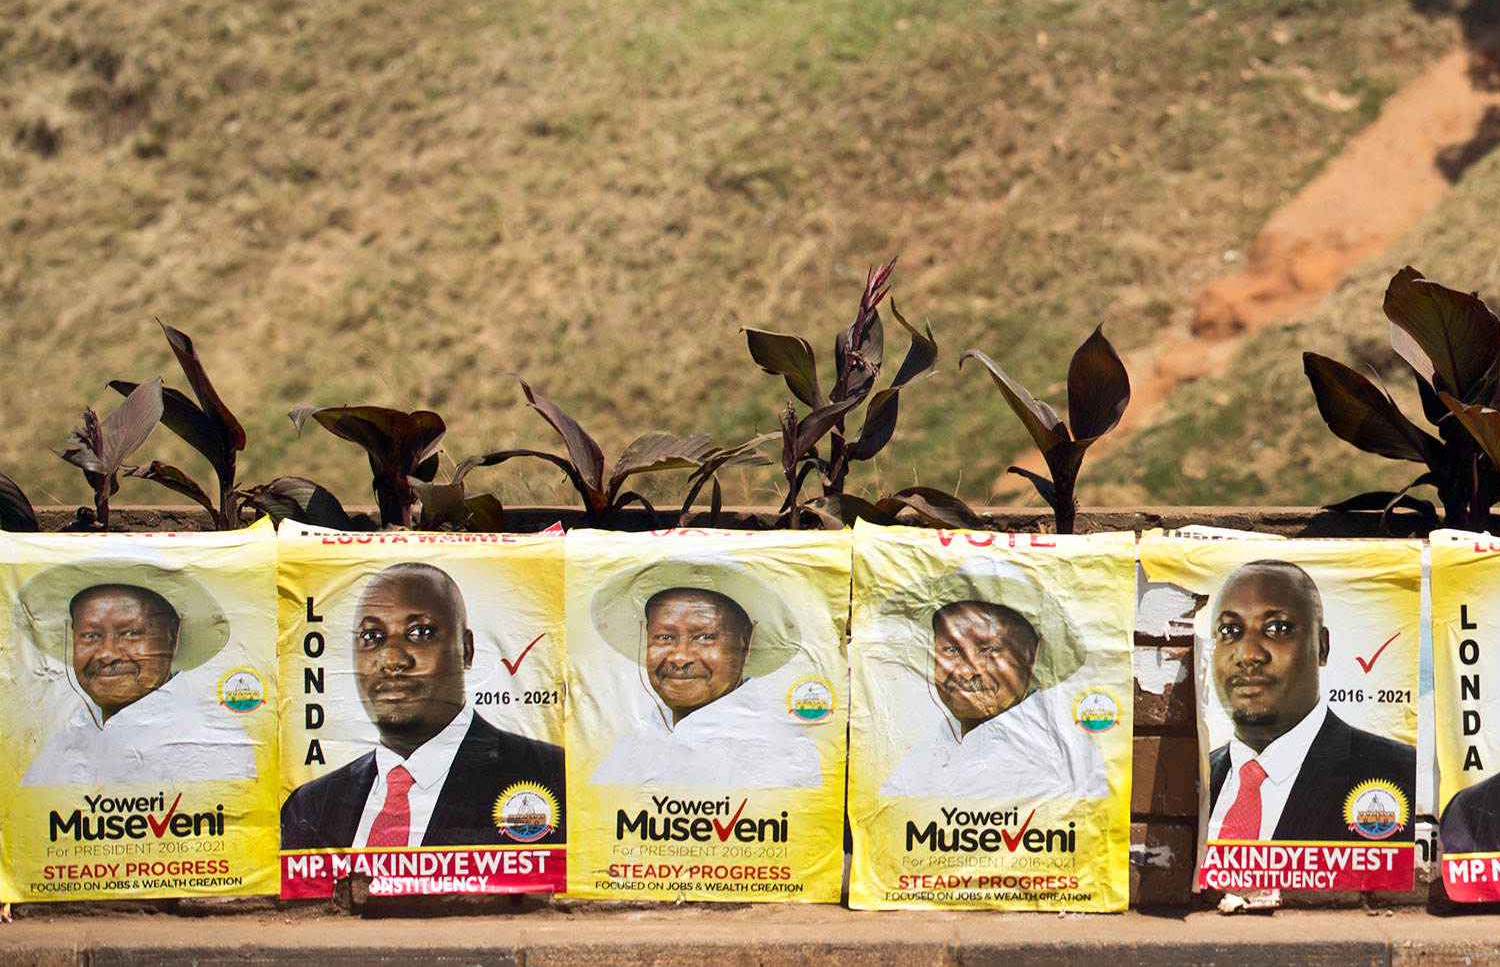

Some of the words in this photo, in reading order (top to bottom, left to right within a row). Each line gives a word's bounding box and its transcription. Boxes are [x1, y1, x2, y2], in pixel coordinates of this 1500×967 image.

[304, 596, 326, 765] LONDA
[1459, 604, 1484, 771] LONDA
[474, 691, 511, 705] 2016
[524, 691, 558, 705] 2021
[1329, 689, 1364, 703] 2016
[1377, 690, 1411, 703] 2021
[84, 792, 164, 813] Yoweri
[652, 796, 730, 816] Yoweri
[49, 793, 225, 842] Museveni
[616, 798, 788, 843] Museveni
[941, 807, 1018, 826] Yoweri
[905, 809, 1076, 853] Museveni
[47, 846, 69, 857] For
[74, 843, 154, 856] PRESIDENT
[158, 841, 225, 854] 2016-2021
[613, 844, 634, 856] For
[641, 845, 718, 857] PRESIDENT
[722, 847, 788, 858] 2016-2021
[1201, 846, 1318, 870] AKINDYE
[1322, 847, 1399, 871] WEST
[44, 863, 120, 880] STEADY
[126, 860, 230, 877] PROGRESS
[287, 855, 327, 879] MP.
[332, 852, 469, 878] MAKINDYE
[473, 850, 551, 874] WEST
[902, 855, 924, 867] For
[929, 856, 1005, 868] PRESIDENT
[1011, 857, 1076, 868] 2016-2021
[609, 864, 684, 879] STEADY
[690, 865, 791, 880] PROGRESS
[1206, 869, 1338, 888] CONSTITUENCY
[1450, 860, 1487, 883] MP.
[31, 882, 81, 893] FOCUSED
[84, 881, 101, 892] ON
[103, 880, 130, 891] JOBS
[133, 880, 140, 890] &
[142, 878, 187, 889] WEALTH
[189, 877, 242, 888] CREATION
[369, 876, 489, 894] ONSTITUENCY
[595, 881, 646, 891] FOCUSED
[648, 882, 664, 891] ON
[666, 882, 694, 891] JOBS
[696, 883, 702, 891] &
[704, 882, 748, 892] WEALTH
[750, 882, 804, 892] CREATION
[899, 875, 973, 890] STEADY
[979, 875, 1079, 890] PROGRESS
[885, 891, 934, 901] FOCUSED
[937, 892, 953, 901] ON
[955, 892, 982, 901] JOBS
[984, 893, 991, 901] &
[993, 892, 1037, 901] WEALTH
